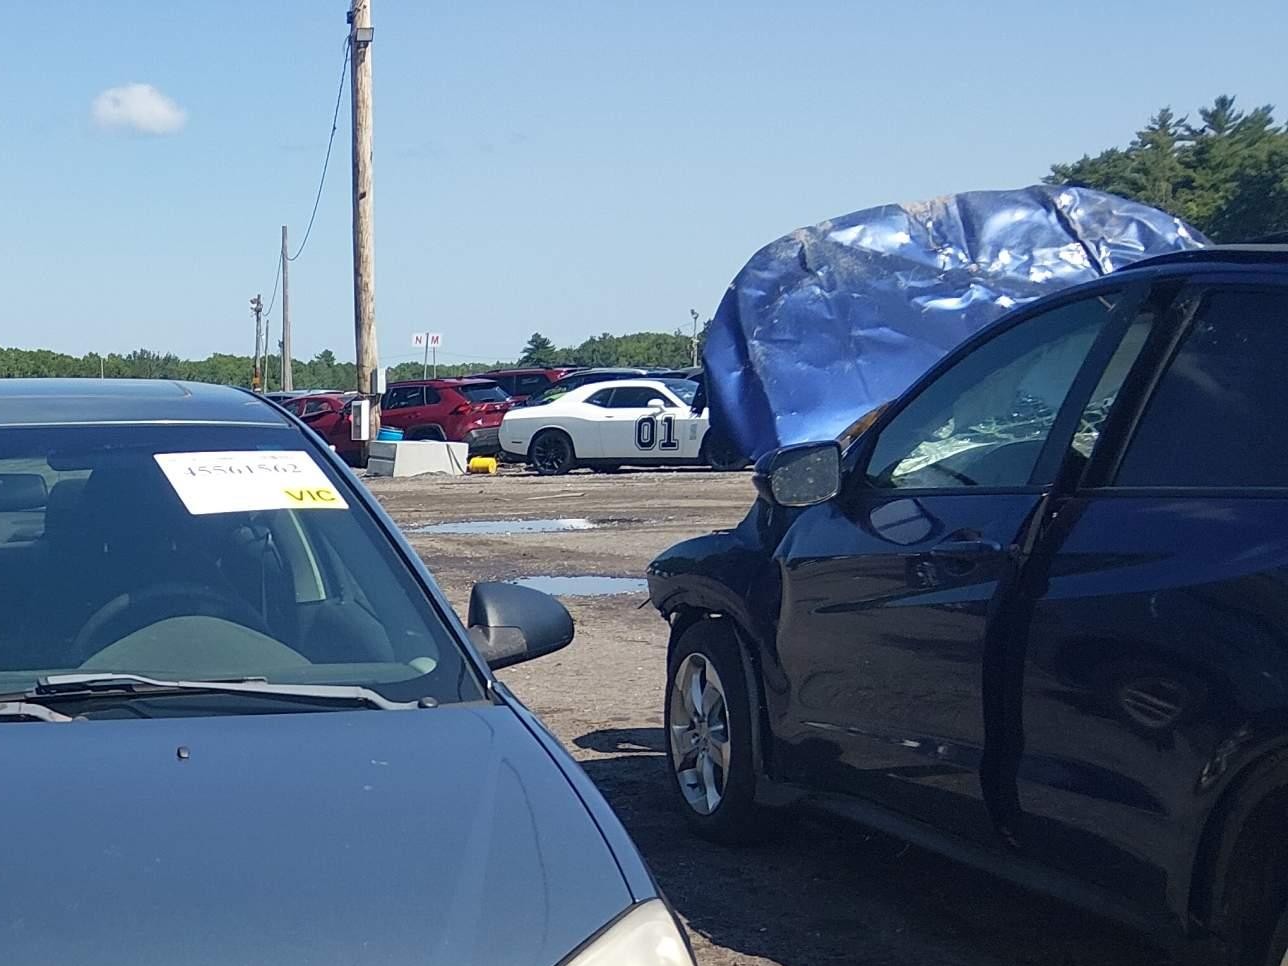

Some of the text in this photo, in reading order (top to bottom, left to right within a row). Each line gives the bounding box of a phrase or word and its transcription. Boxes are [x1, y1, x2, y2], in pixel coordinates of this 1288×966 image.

[415, 335, 423, 345] N
[430, 335, 440, 345] M
[635, 414, 680, 451] 01
[284, 489, 337, 502] VIC
